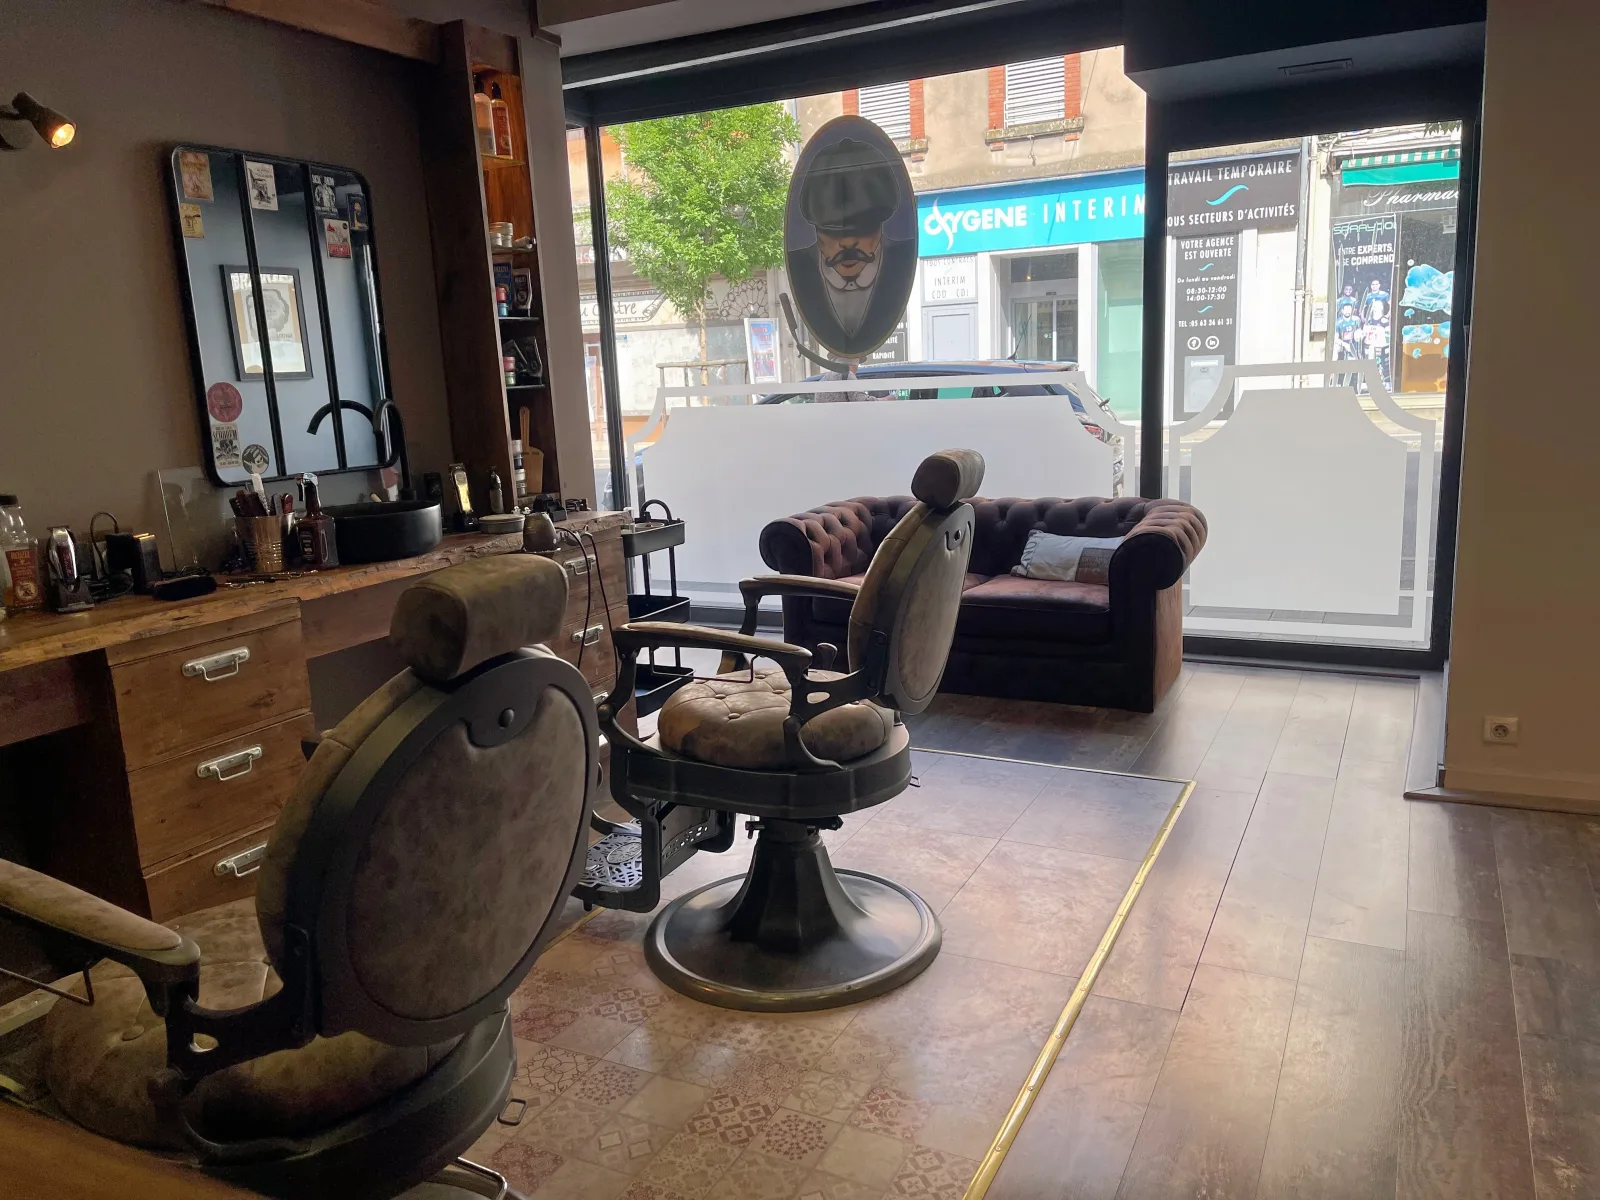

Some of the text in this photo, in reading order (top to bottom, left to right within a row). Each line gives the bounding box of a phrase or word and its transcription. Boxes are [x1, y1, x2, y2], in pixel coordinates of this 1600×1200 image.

[1168, 160, 1293, 186] TRAVAIL TEMPORAIRE
[1167, 203, 1295, 227] OUS SECTEURS D'ACTIVITÉS
[1180, 236, 1234, 250] VOTRE AGENCE
[1184, 248, 1232, 260] EST OUVERTE
[934, 276, 966, 287] INTERIM
[956, 288, 969, 298] CDI
[1186, 285, 1228, 295] 08:30-12:00
[1186, 293, 1226, 302] 14:00-17:30
[1178, 320, 1188, 328] TEL
